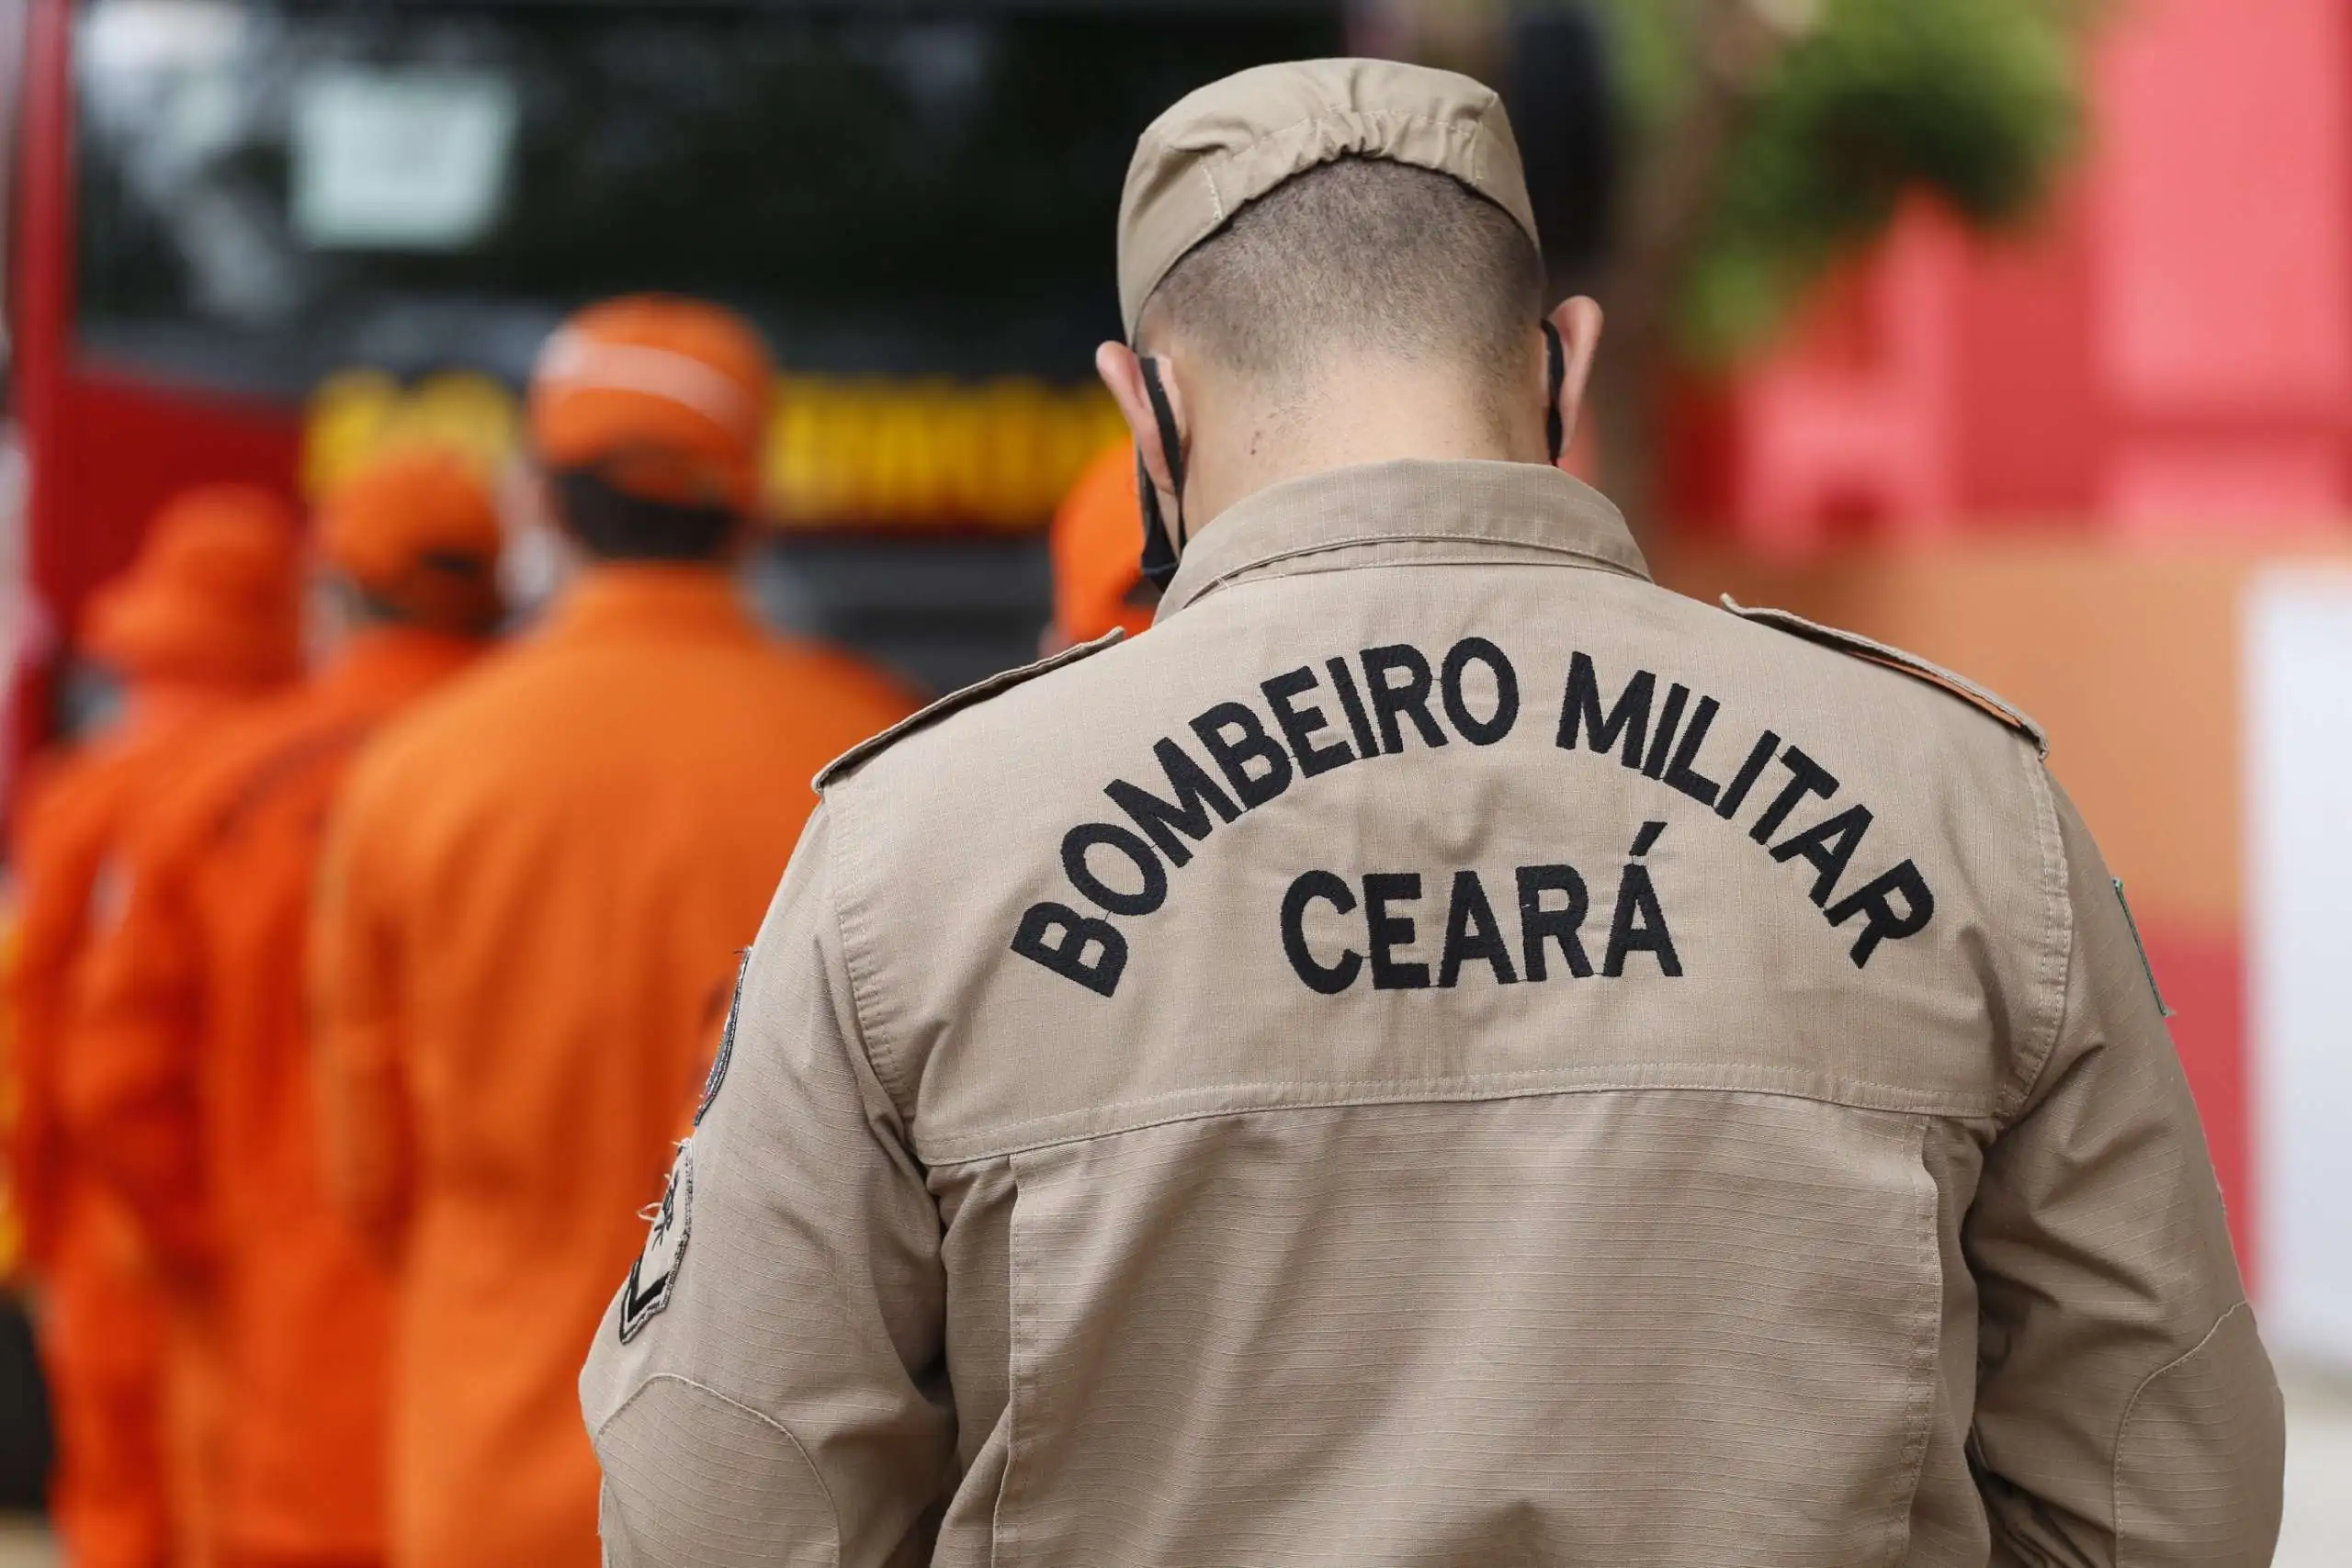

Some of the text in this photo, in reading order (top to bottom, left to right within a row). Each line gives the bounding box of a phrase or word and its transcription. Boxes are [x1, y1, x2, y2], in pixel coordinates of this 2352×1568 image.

[1011, 637, 1935, 998] BOMBEIRO MILITAR
[1280, 820, 1684, 995] CEARÁ
